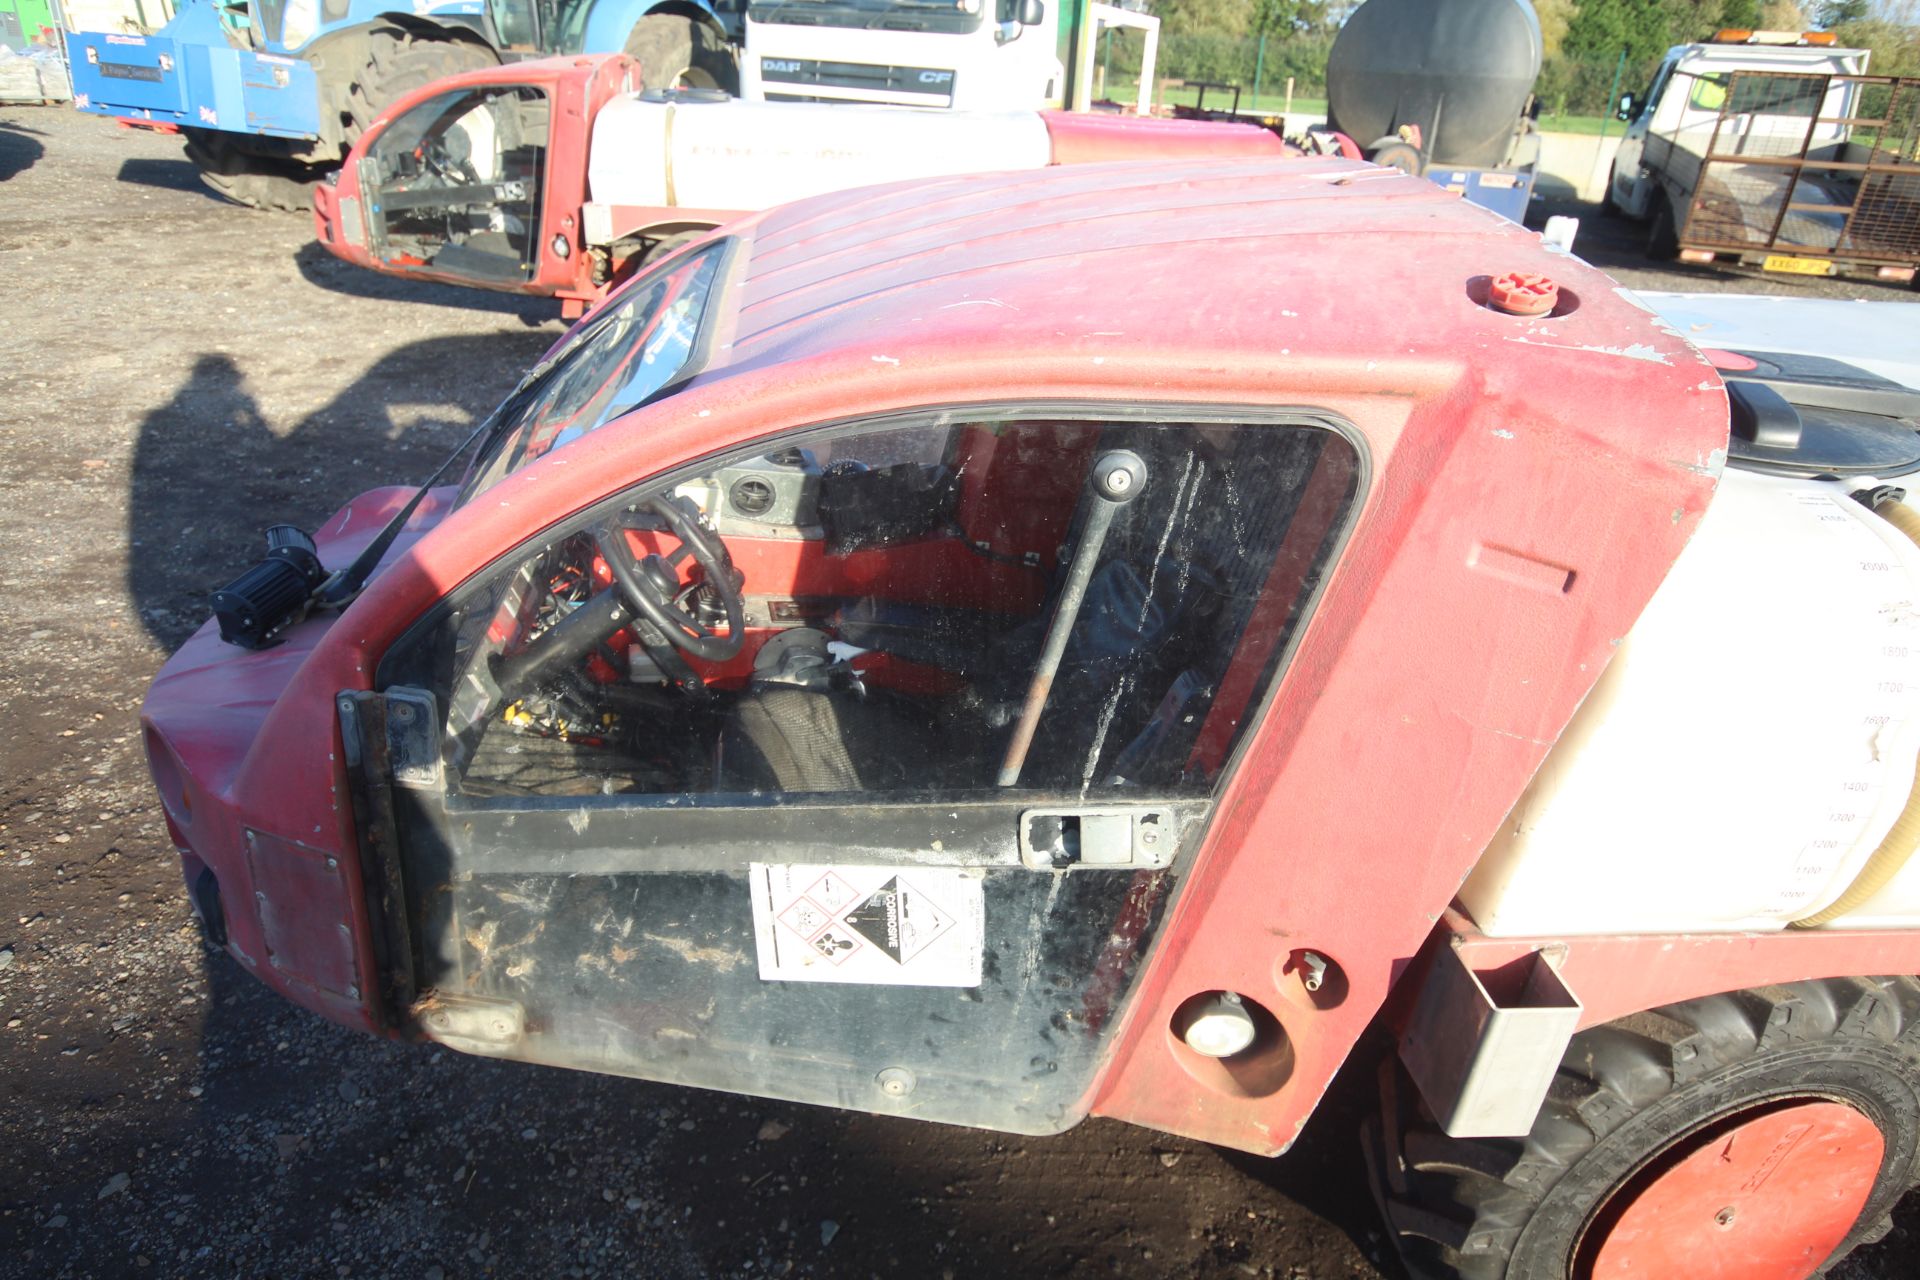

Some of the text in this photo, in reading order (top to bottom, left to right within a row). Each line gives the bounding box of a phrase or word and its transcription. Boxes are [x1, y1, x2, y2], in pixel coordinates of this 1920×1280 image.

[762, 59, 953, 83] DAF CF
[1859, 561, 1889, 572] 2000
[1877, 682, 1904, 693] 1700
[1863, 715, 1890, 725] 1600
[1842, 782, 1869, 792] 1400
[1829, 813, 1855, 823] 1300
[1812, 840, 1838, 849] 1200
[846, 916, 858, 924] 8
[884, 894, 899, 949] CORROSIVE
